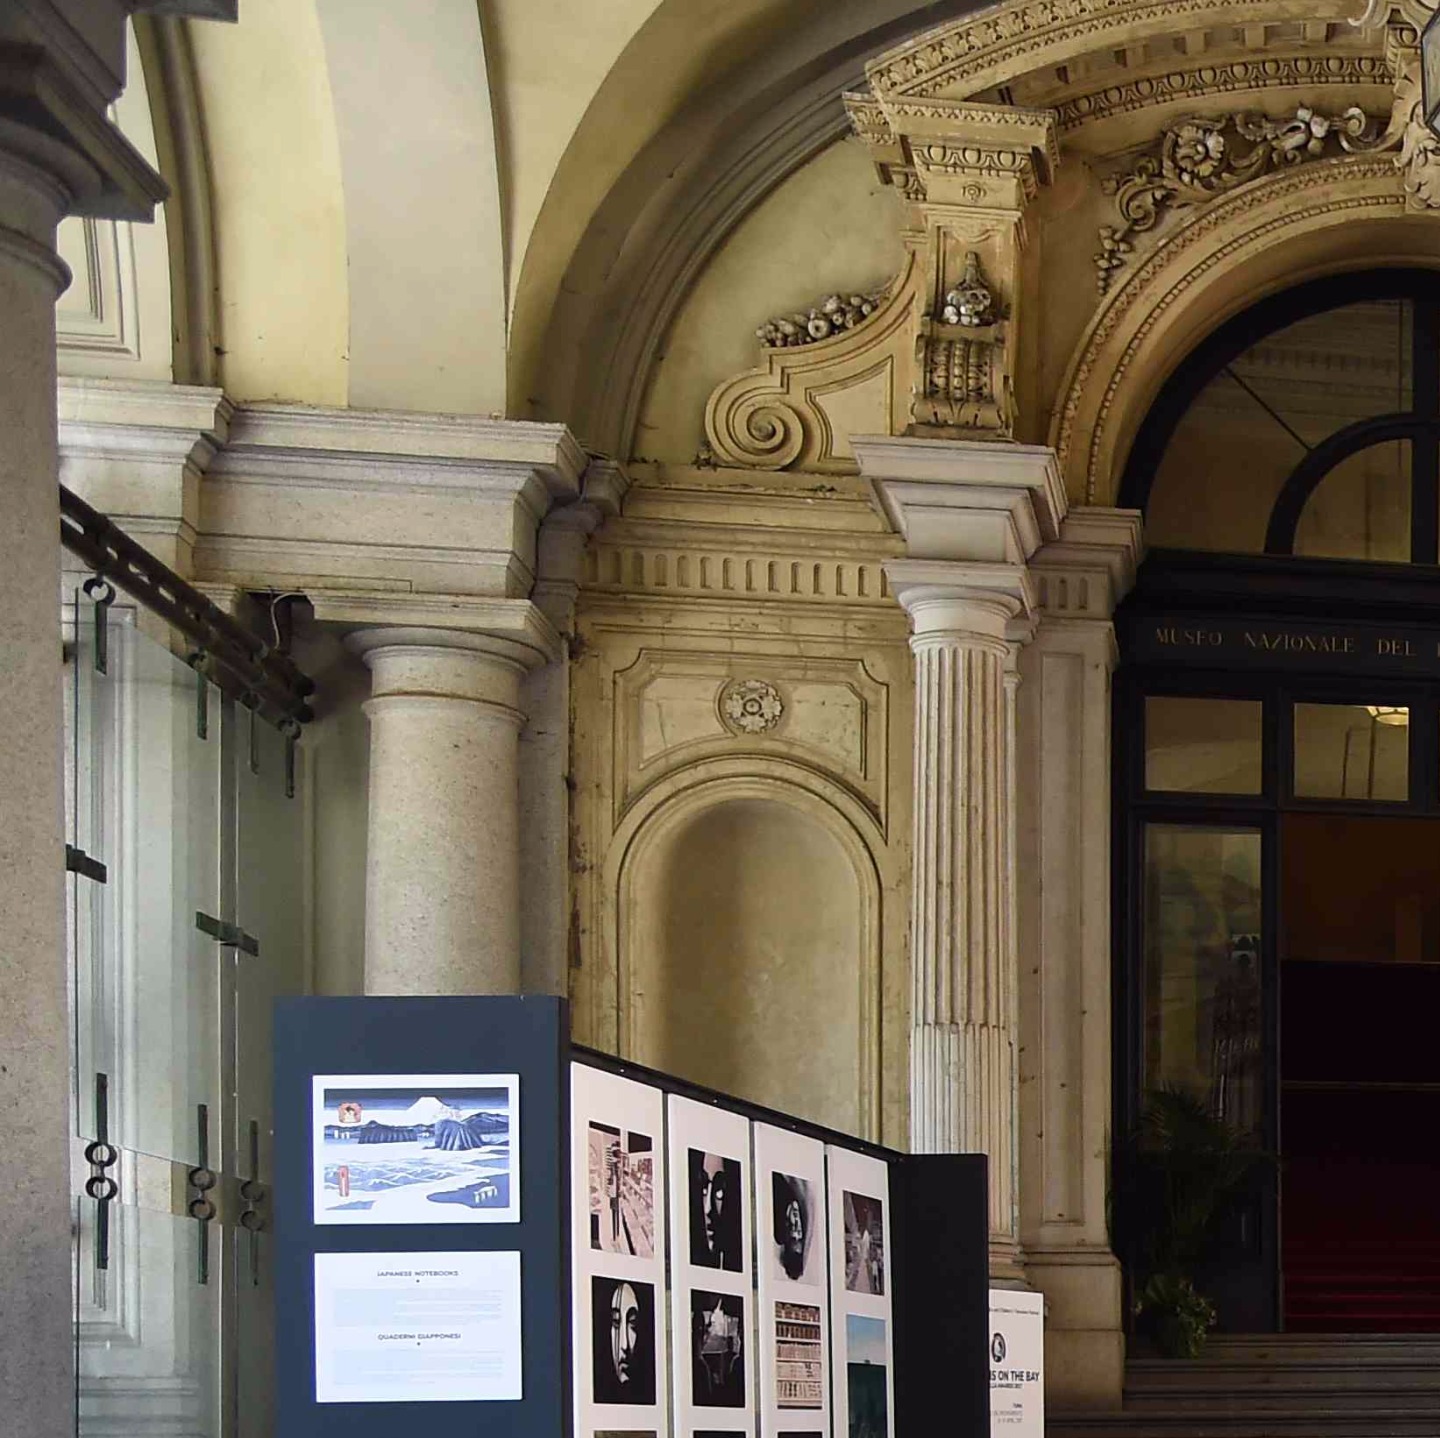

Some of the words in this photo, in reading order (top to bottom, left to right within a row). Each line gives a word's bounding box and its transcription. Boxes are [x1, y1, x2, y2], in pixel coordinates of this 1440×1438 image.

[1156, 627, 1223, 647] MUSEO
[1244, 631, 1355, 653] NAZIONALE
[1377, 638, 1417, 657] DEL
[1010, 1370, 1024, 1382] THE
[1025, 1371, 1040, 1382] BAY
